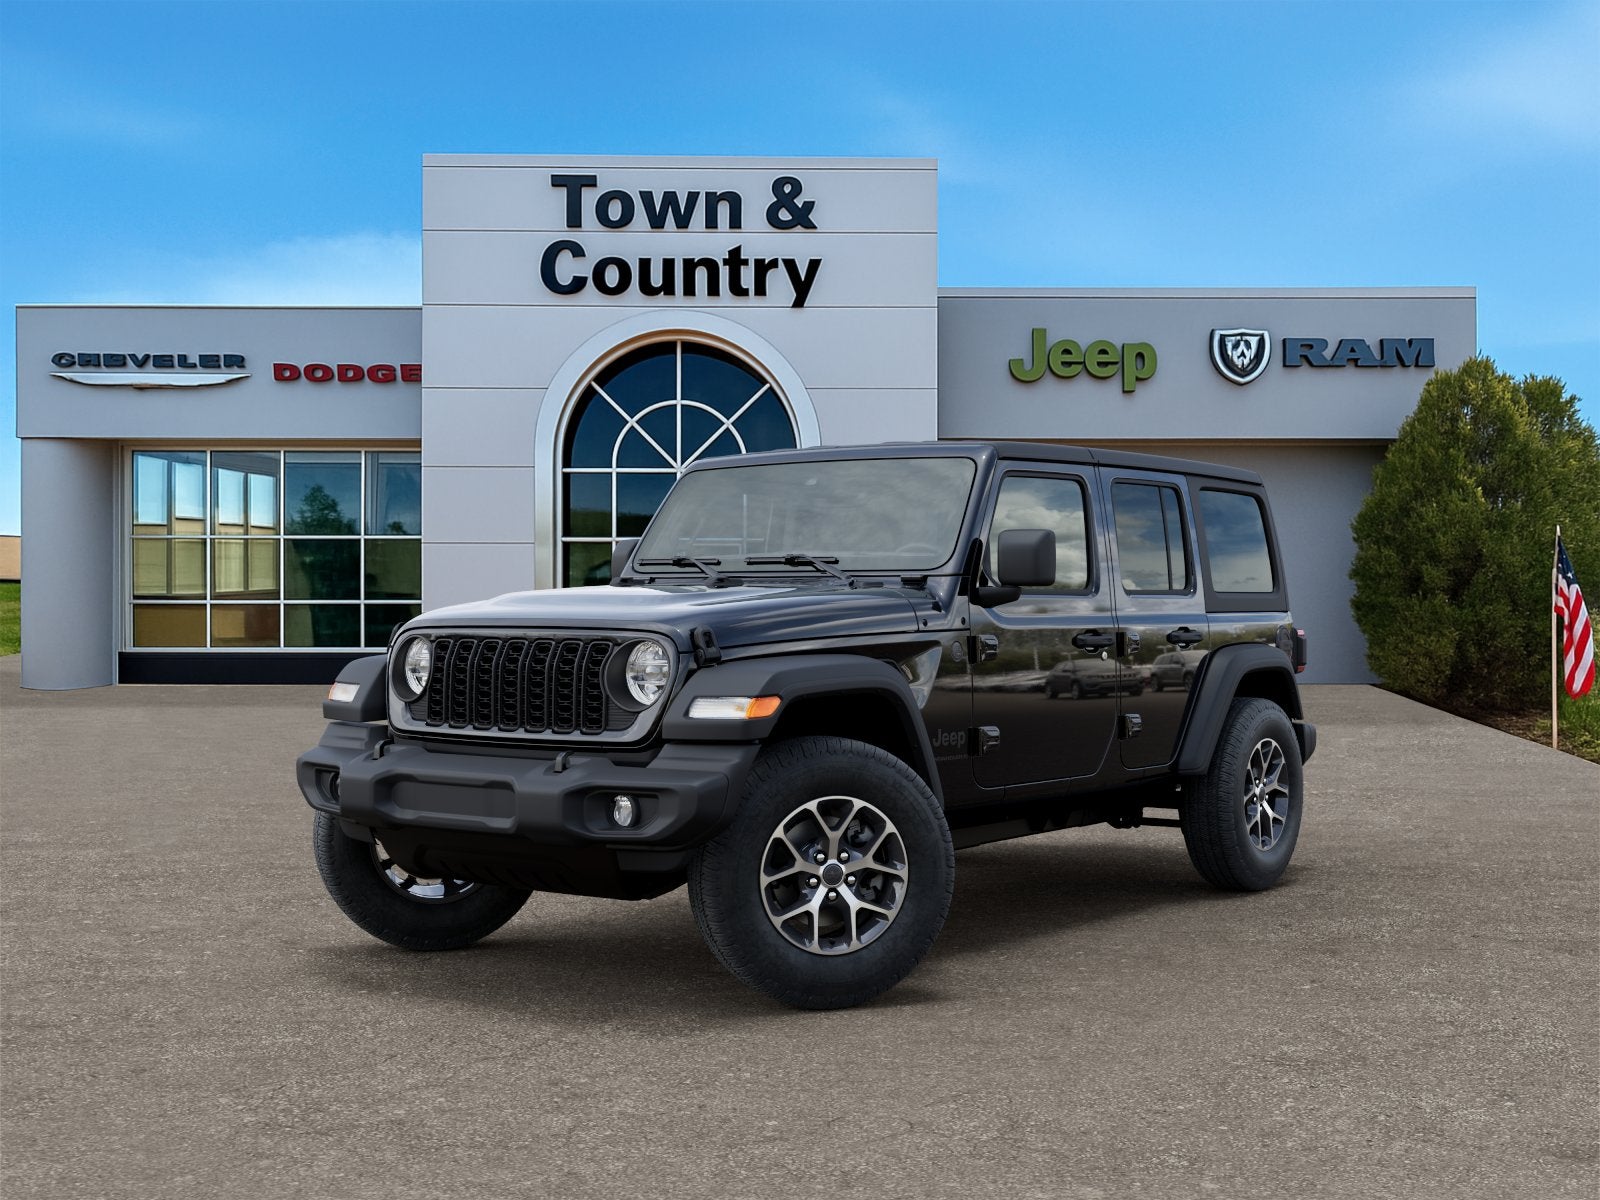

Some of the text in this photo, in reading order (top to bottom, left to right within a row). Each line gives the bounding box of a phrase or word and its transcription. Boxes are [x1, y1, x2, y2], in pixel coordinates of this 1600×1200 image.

[550, 174, 818, 230] Town &
[540, 239, 823, 308] Country
[272, 363, 422, 383] DODGE
[1009, 327, 1158, 393] Jeep
[1282, 337, 1435, 367] RAM
[932, 728, 966, 748] Jeep
